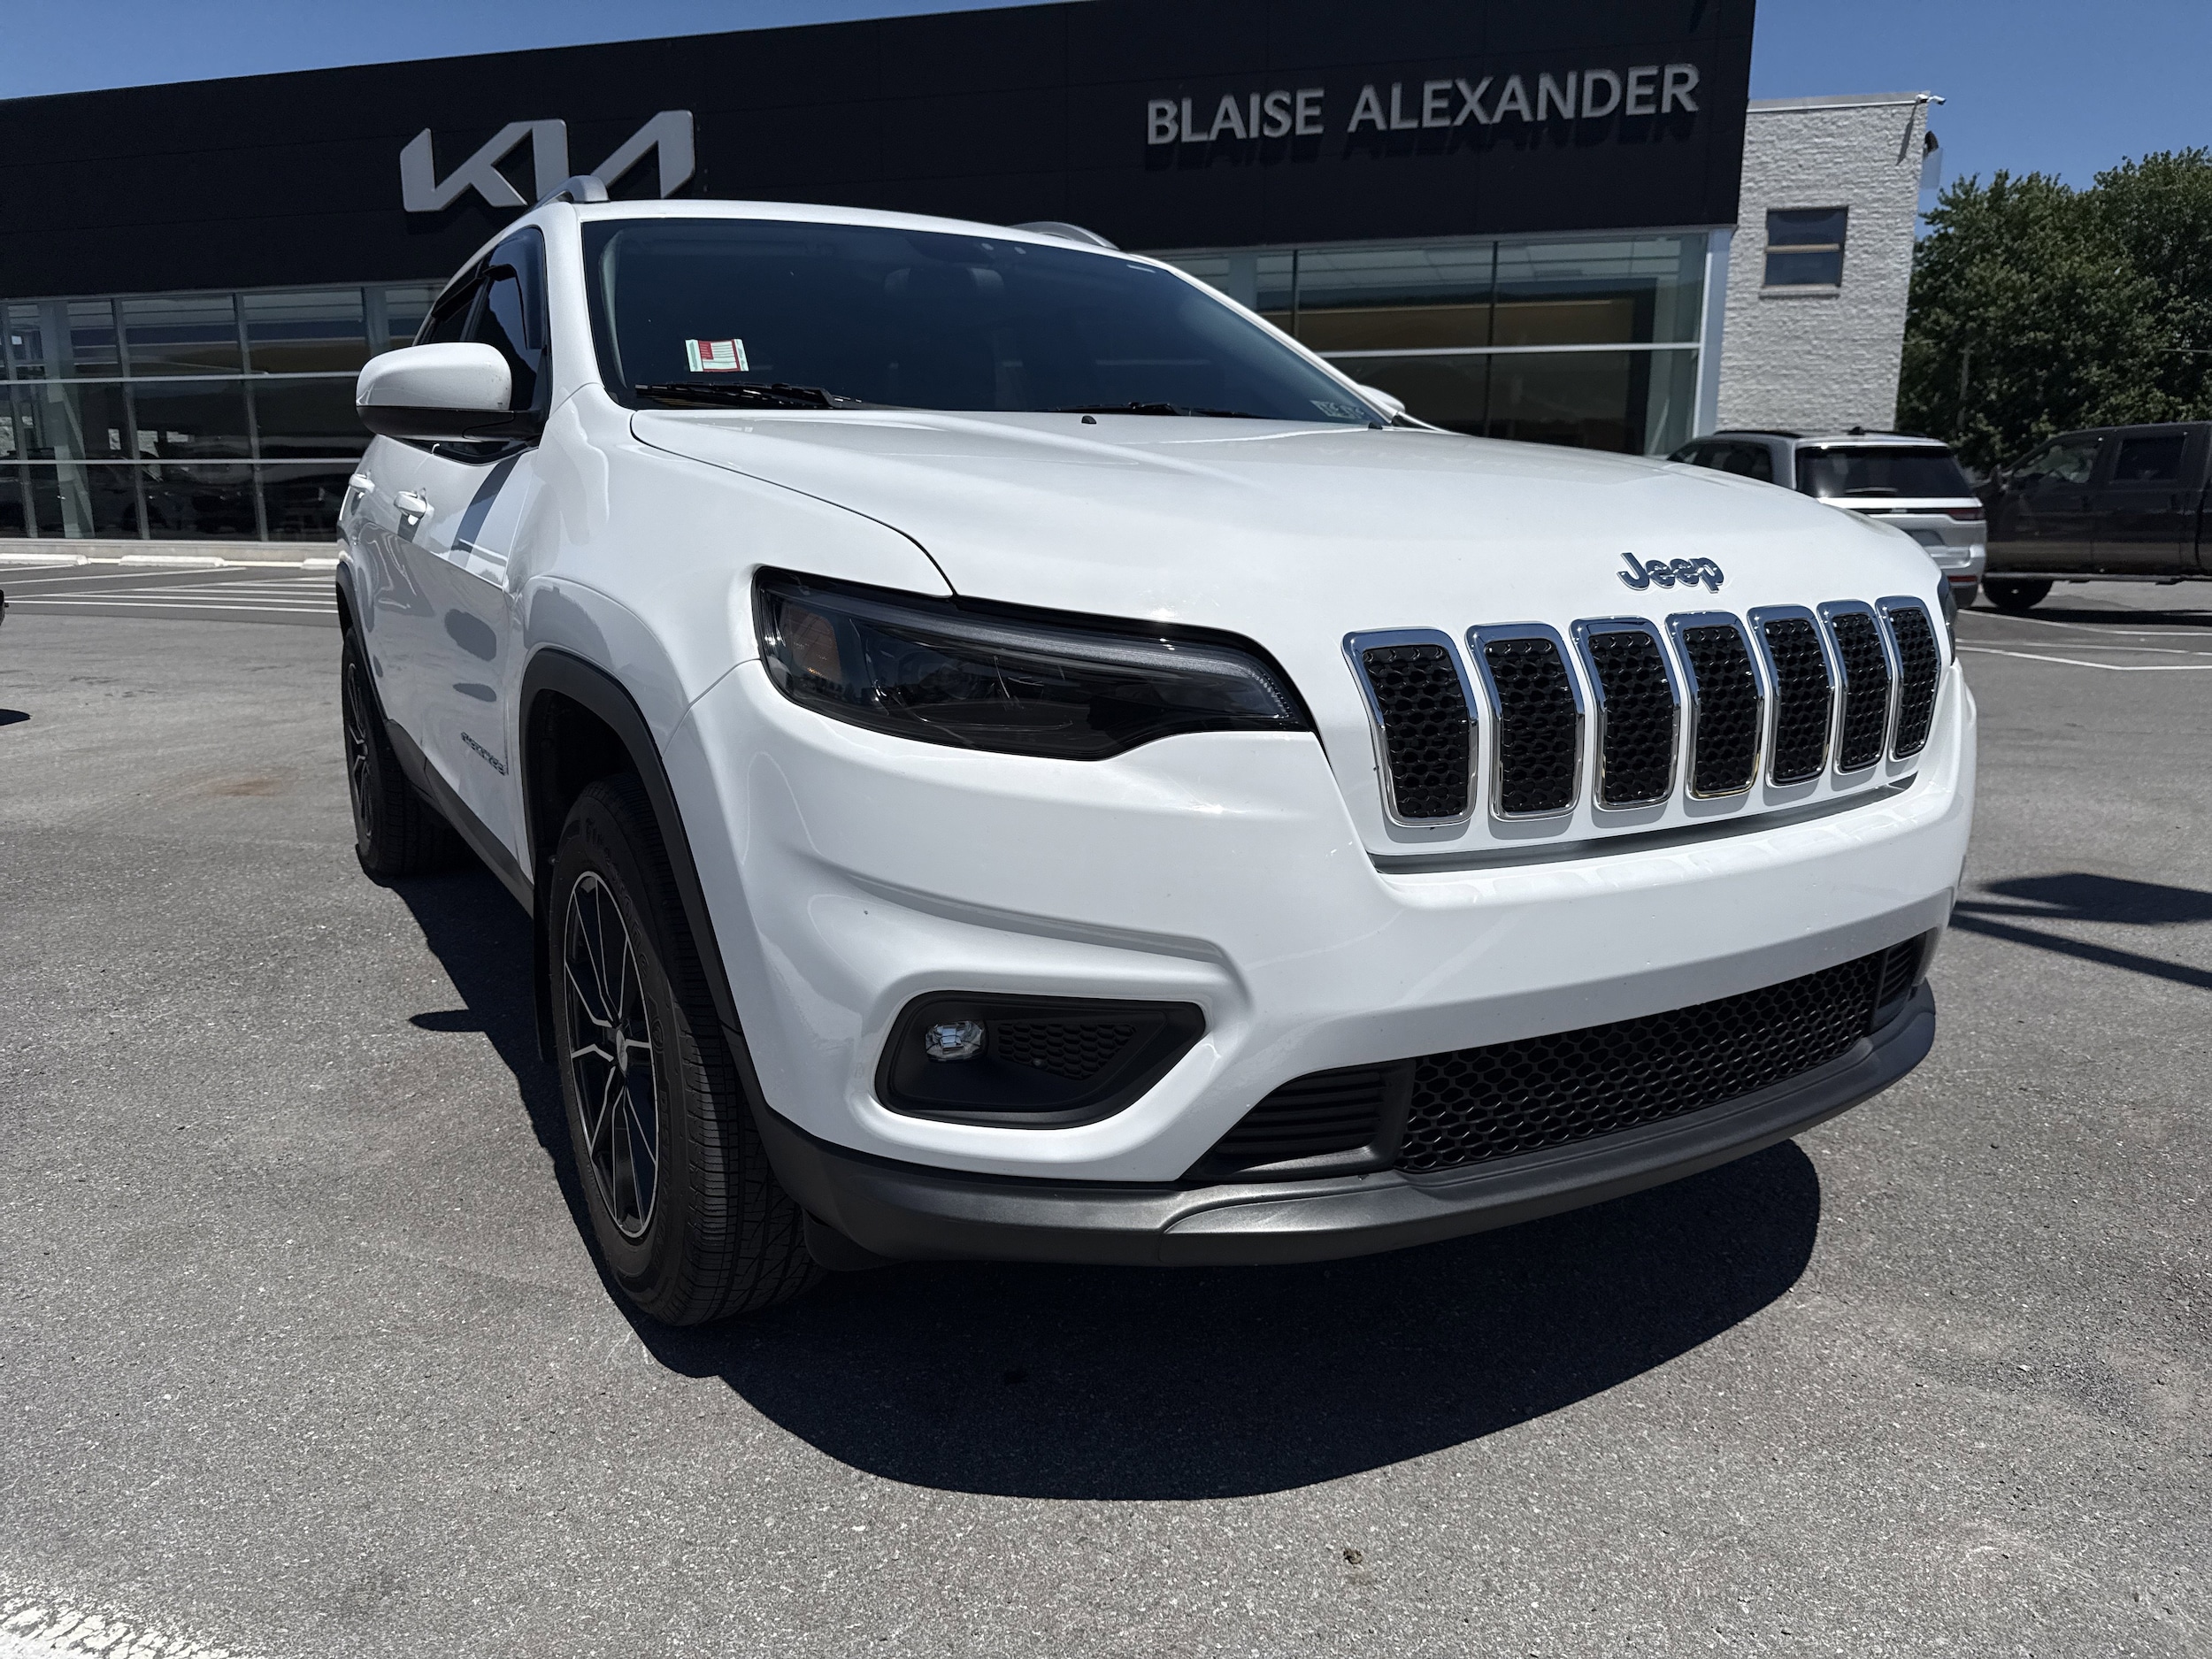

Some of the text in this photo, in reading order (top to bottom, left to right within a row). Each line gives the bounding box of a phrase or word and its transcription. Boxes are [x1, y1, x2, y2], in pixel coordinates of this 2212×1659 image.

[1147, 62, 1700, 145] BLAISE ALEXANDER
[400, 109, 695, 212] KIA
[1616, 552, 1724, 594] Jeep
